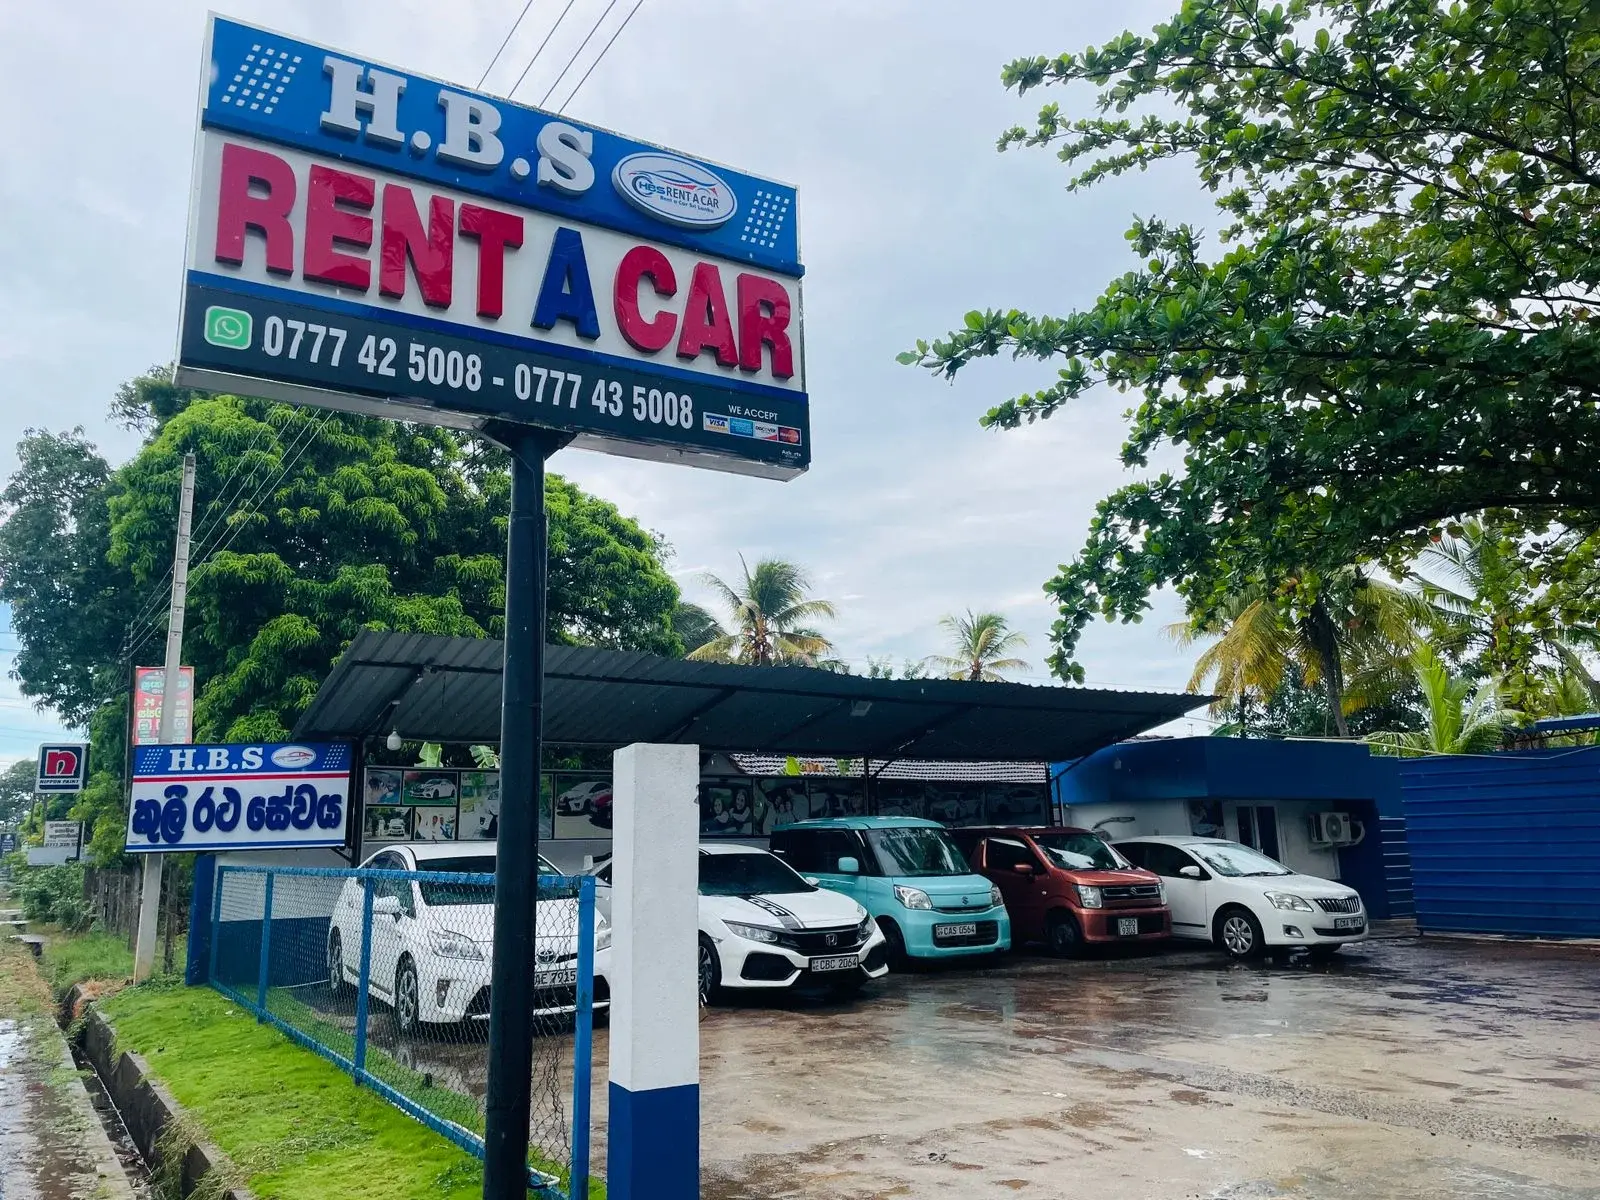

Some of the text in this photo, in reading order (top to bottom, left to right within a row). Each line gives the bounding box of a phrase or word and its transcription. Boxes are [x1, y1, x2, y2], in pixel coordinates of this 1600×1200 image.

[319, 55, 595, 196] H.B.S
[666, 186, 691, 201] RENT
[693, 193, 700, 204] A
[701, 195, 719, 209] CAR
[214, 142, 794, 381] RENT A CAR
[263, 315, 348, 367] 0777
[358, 335, 397, 378] 42
[408, 342, 482, 392] 5008
[514, 363, 582, 409] 0777
[592, 379, 624, 417] 43
[633, 385, 694, 430] 5008
[709, 418, 726, 427] VISA
[728, 404, 778, 421] WE ACCEPT
[167, 747, 264, 772] H.B.S
[132, 784, 189, 844] කුලි
[246, 783, 342, 832] සේවය
[838, 957, 857, 968] 2064
[550, 970, 576, 983] 7915
